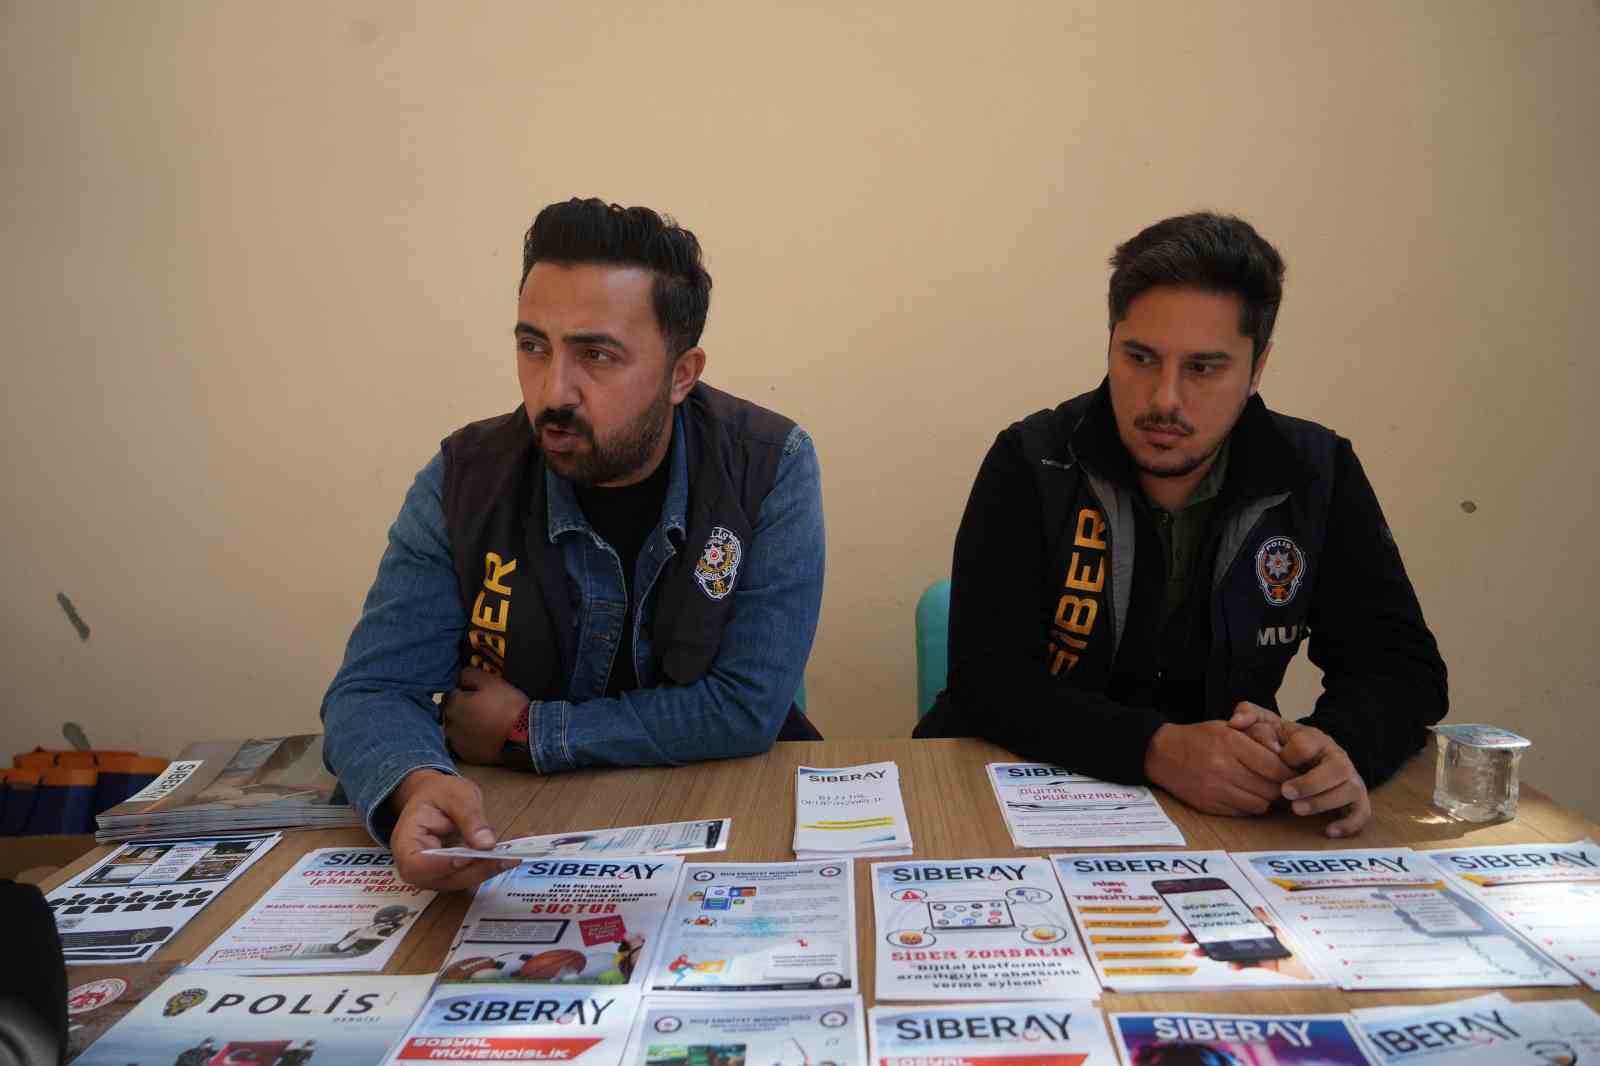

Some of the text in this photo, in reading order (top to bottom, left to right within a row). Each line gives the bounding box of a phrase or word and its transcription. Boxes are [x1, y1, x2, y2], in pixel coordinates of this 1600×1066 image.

[1256, 624, 1304, 648] MU
[207, 988, 380, 1015] POLİS
[413, 1038, 492, 1048] SOSYAL
